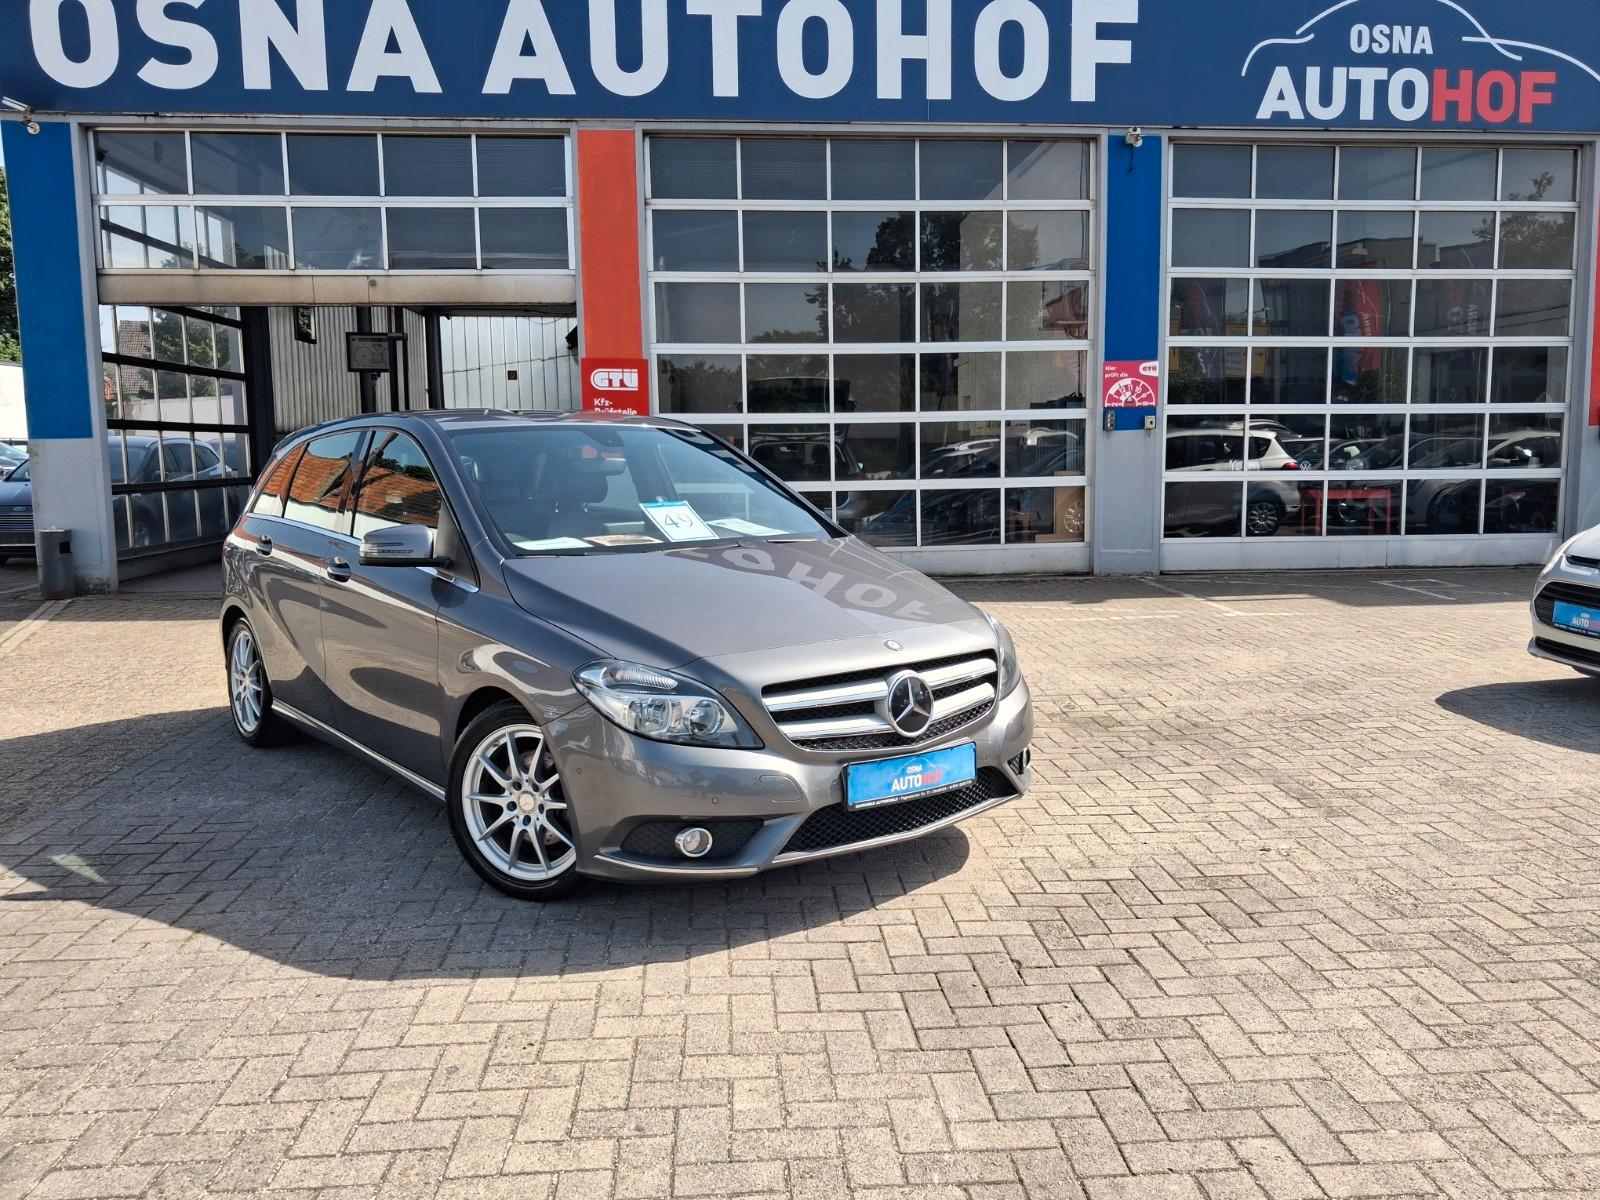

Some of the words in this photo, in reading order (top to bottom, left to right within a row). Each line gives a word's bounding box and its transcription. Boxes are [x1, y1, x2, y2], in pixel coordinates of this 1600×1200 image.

[29, 0, 443, 93] OSNA
[481, 0, 1138, 102] AUTOHOF
[1350, 23, 1434, 55] OSNA
[1255, 65, 1557, 124] AUTOHOF
[594, 398, 613, 406] Kfz-
